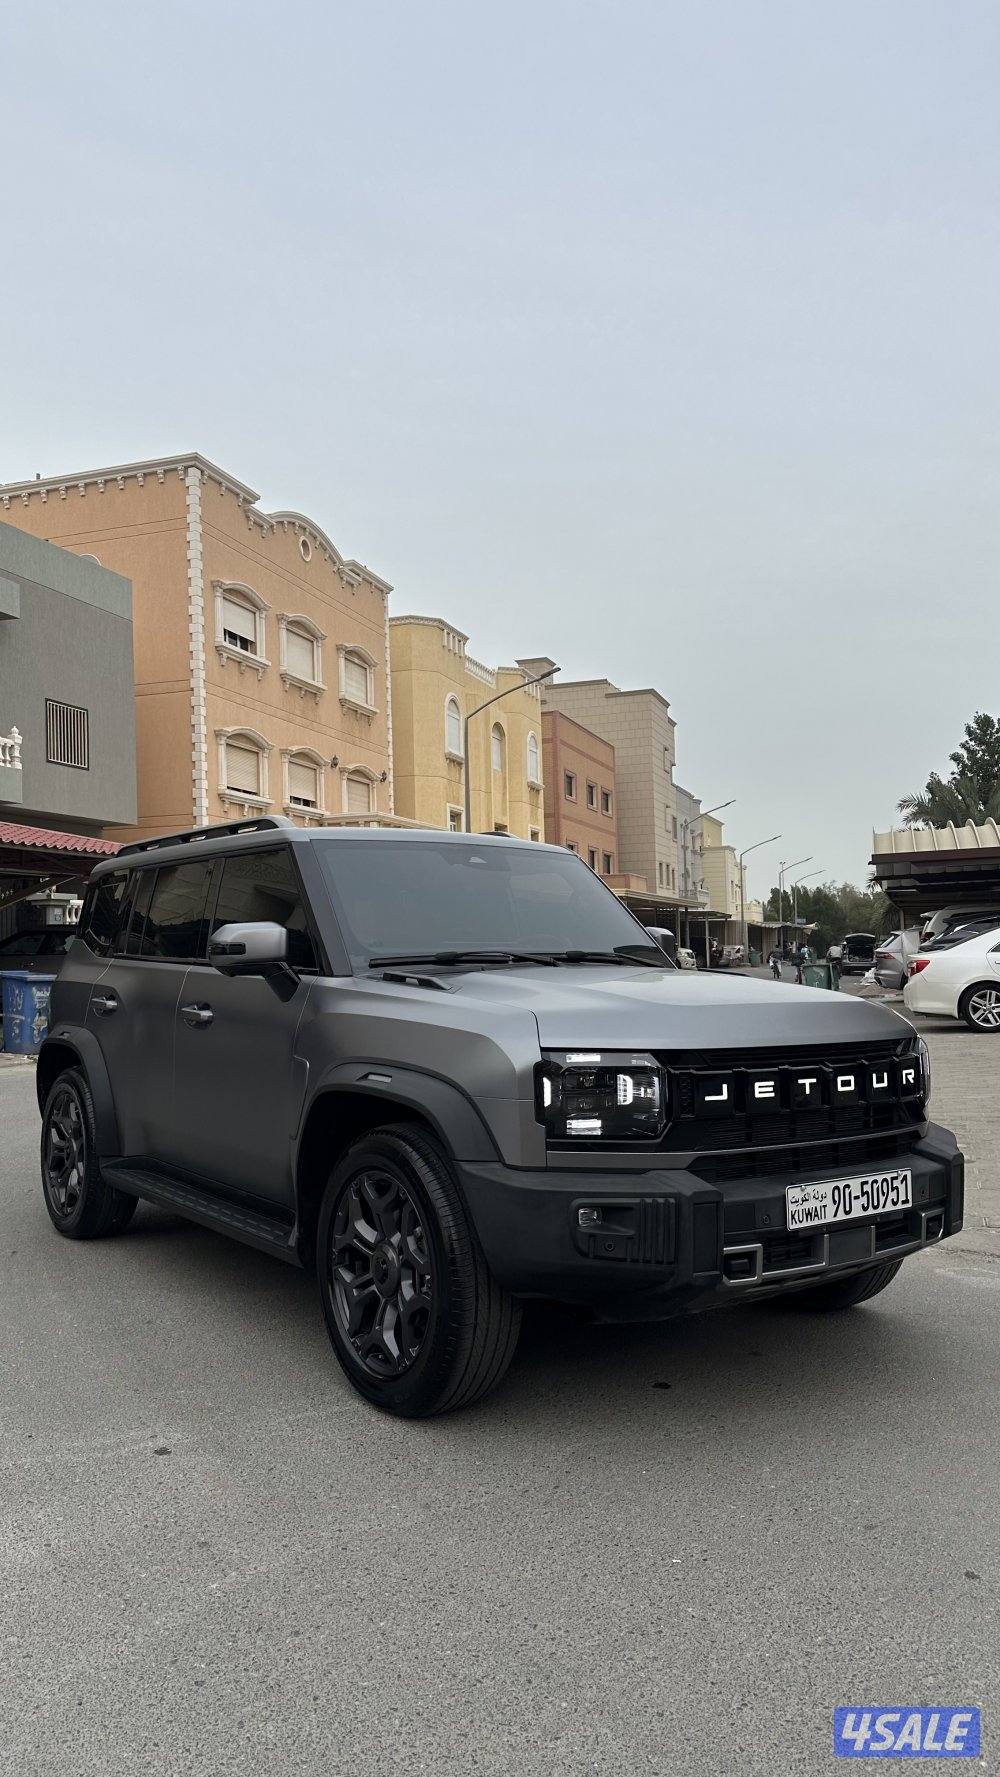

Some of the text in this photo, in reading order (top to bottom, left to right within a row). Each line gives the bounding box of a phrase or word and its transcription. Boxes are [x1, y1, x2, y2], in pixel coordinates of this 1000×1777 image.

[704, 1069, 915, 1101] JETOUR
[790, 1189, 827, 1206] دولة الكويت
[831, 1174, 910, 1218] 90-50951
[790, 1204, 828, 1225] KUWAIT
